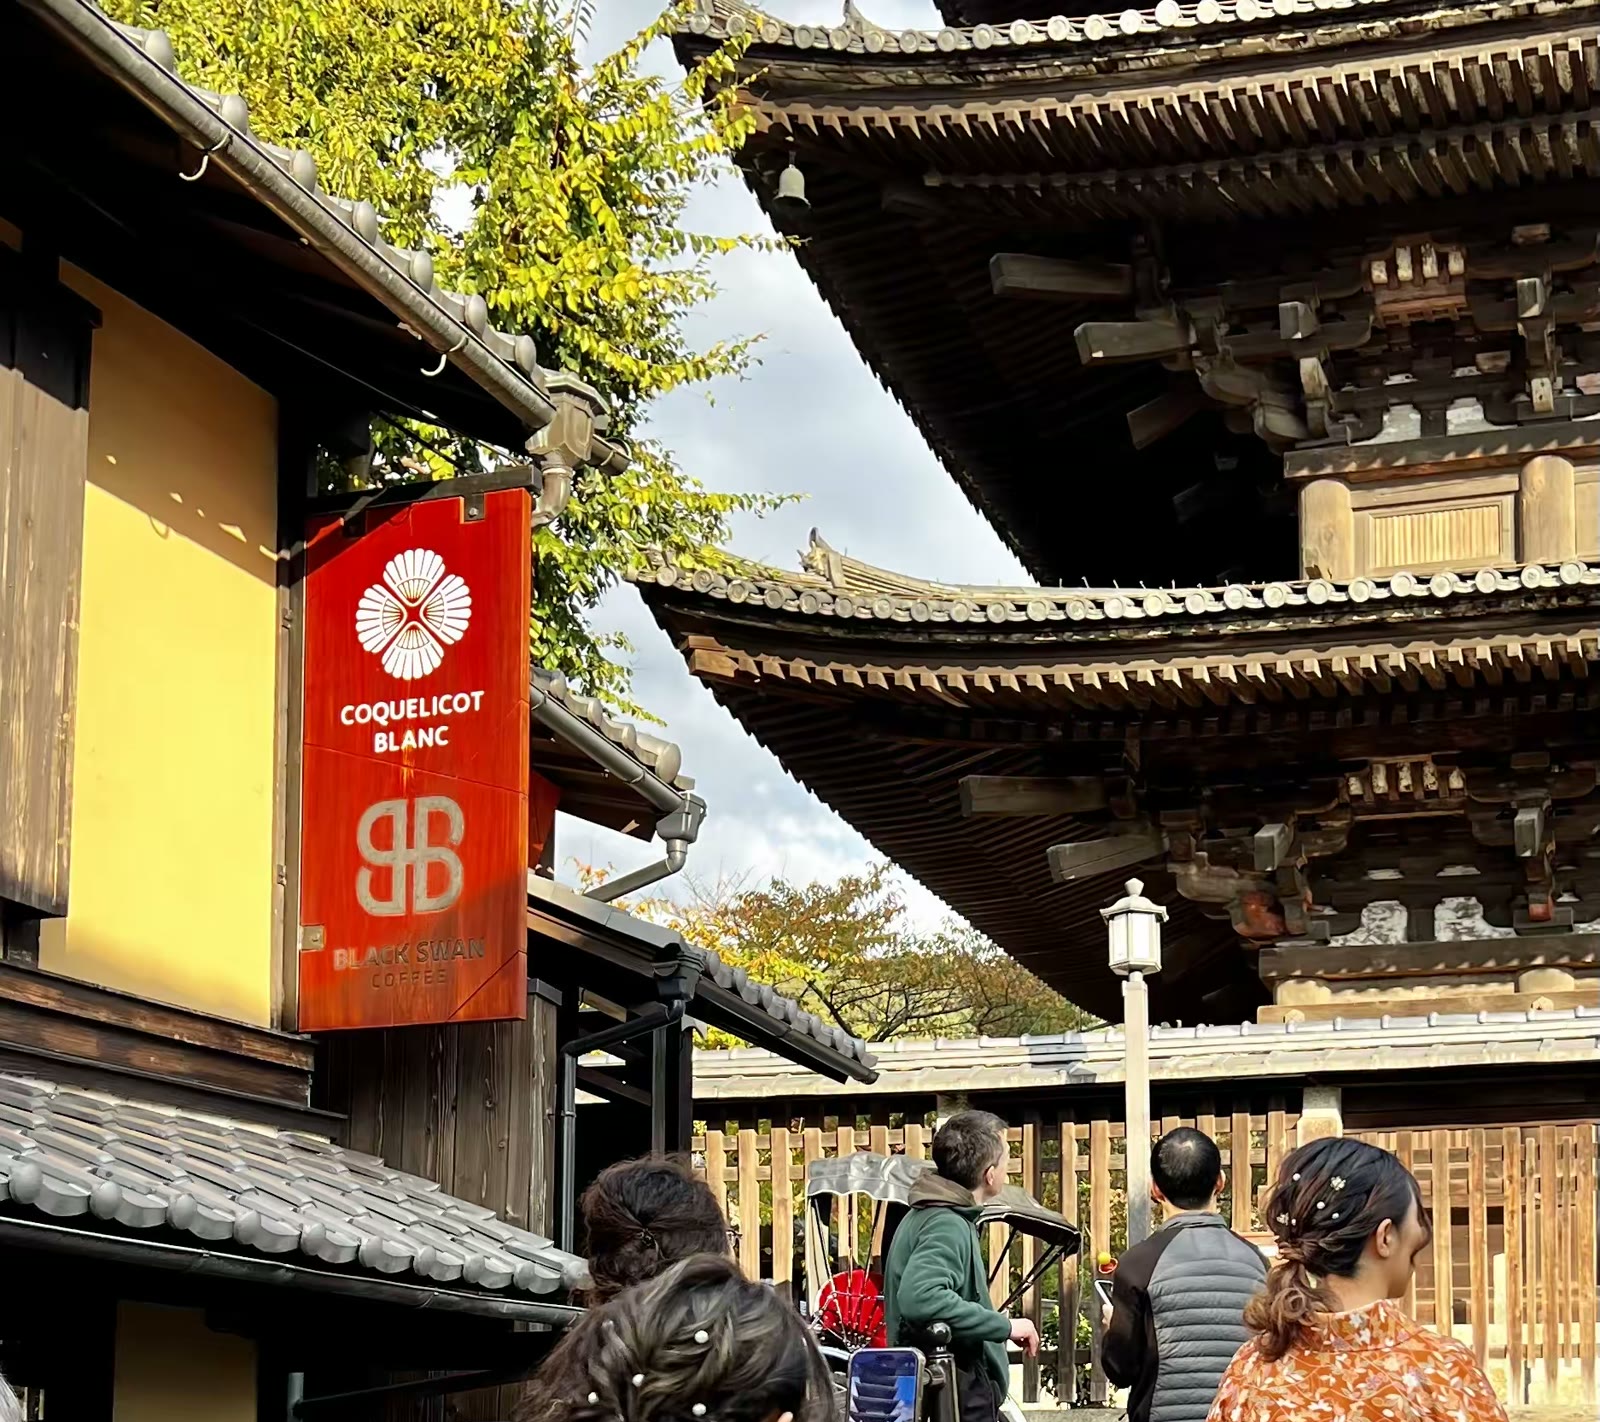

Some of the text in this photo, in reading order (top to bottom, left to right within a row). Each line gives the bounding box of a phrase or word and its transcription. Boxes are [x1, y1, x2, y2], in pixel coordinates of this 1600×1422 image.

[340, 689, 485, 727] COQUELICOT
[373, 725, 450, 754] BLANC
[333, 936, 486, 971] BLACK SWAN
[371, 968, 448, 989] COFFEE
